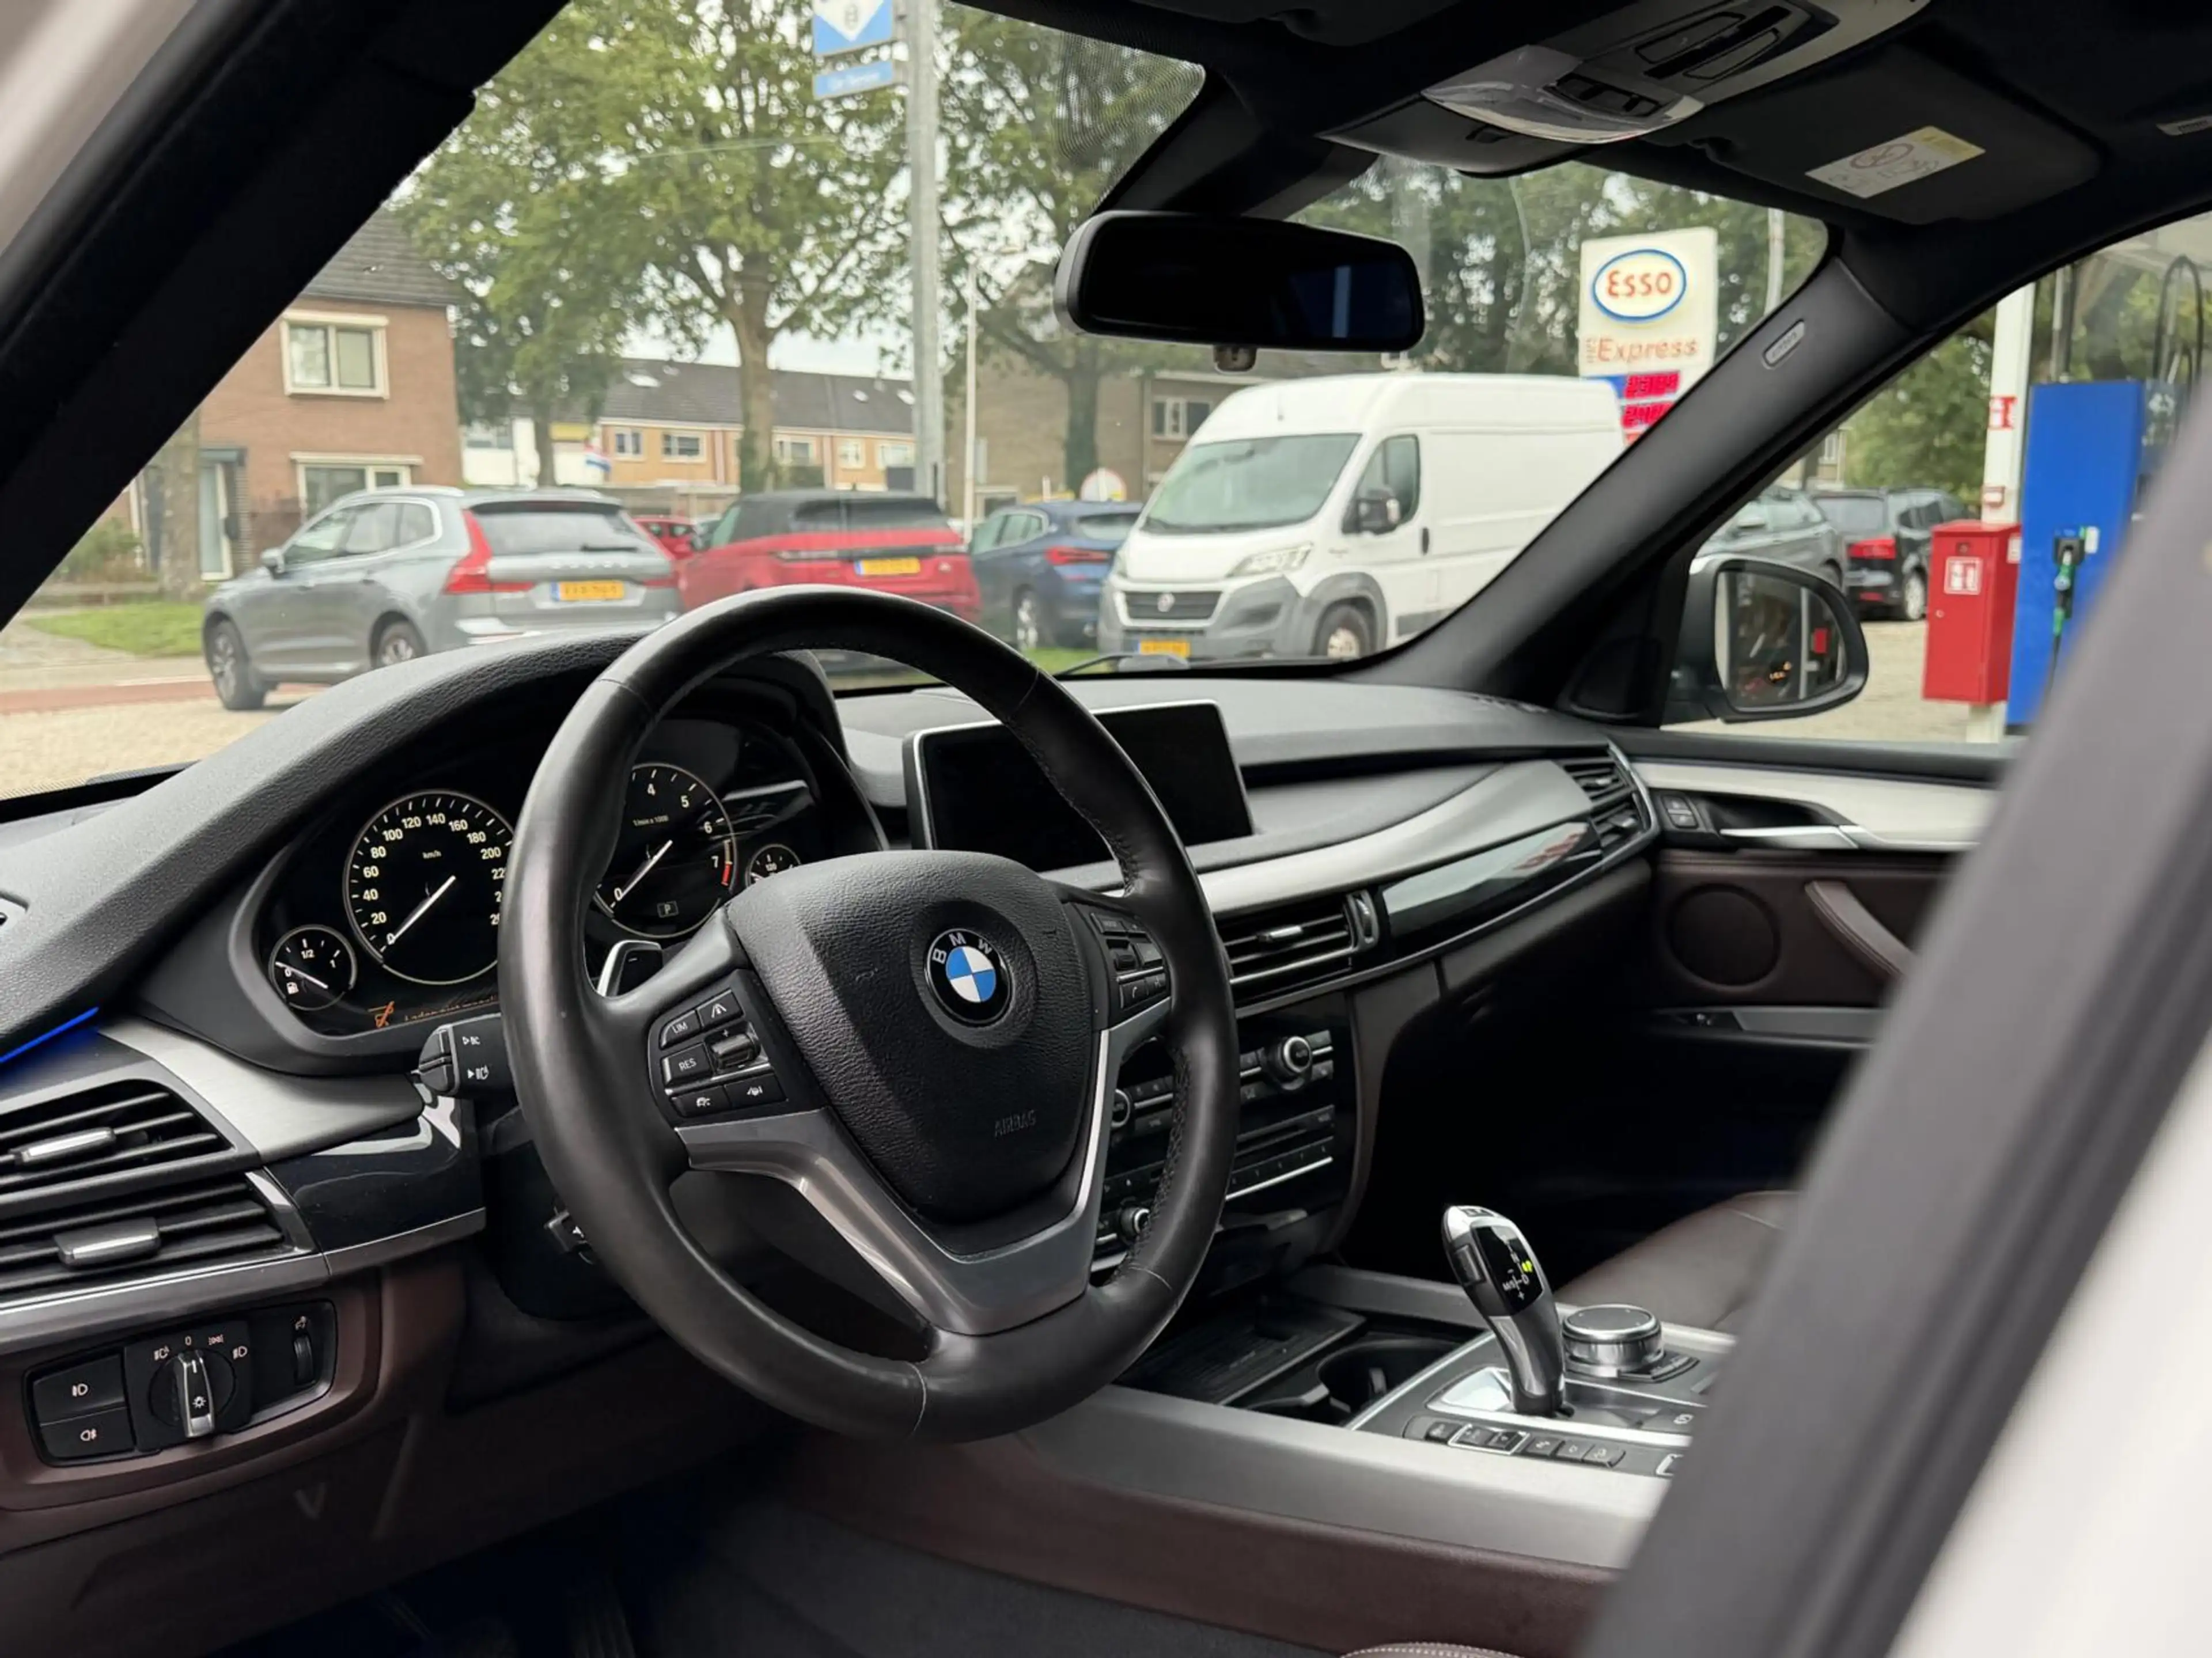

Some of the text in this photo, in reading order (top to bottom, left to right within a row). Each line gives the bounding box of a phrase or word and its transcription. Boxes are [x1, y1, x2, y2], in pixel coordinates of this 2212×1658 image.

[1597, 336, 1697, 363] Express
[647, 783, 656, 796] 4
[680, 795, 690, 808] 5
[401, 816, 422, 829] 120
[426, 813, 445, 825] 140
[449, 819, 468, 832] 160
[704, 821, 712, 834] 6
[382, 828, 403, 841] 100
[467, 831, 487, 844] 180
[370, 845, 387, 859] 80
[480, 847, 501, 860] 200
[711, 855, 719, 868] 7
[363, 865, 379, 878] 60
[491, 867, 506, 880] 22
[363, 888, 378, 901] 40
[613, 887, 624, 901] 0
[664, 904, 672, 915] P
[370, 912, 387, 924] 20
[386, 932, 396, 945] 0
[301, 949, 315, 959] 1/2
[932, 932, 992, 965] BMW
[329, 959, 336, 968] 1
[285, 967, 291, 977] 0
[672, 1022, 688, 1034] LIM
[679, 1058, 697, 1072] RES
[185, 1335, 191, 1346] 0
